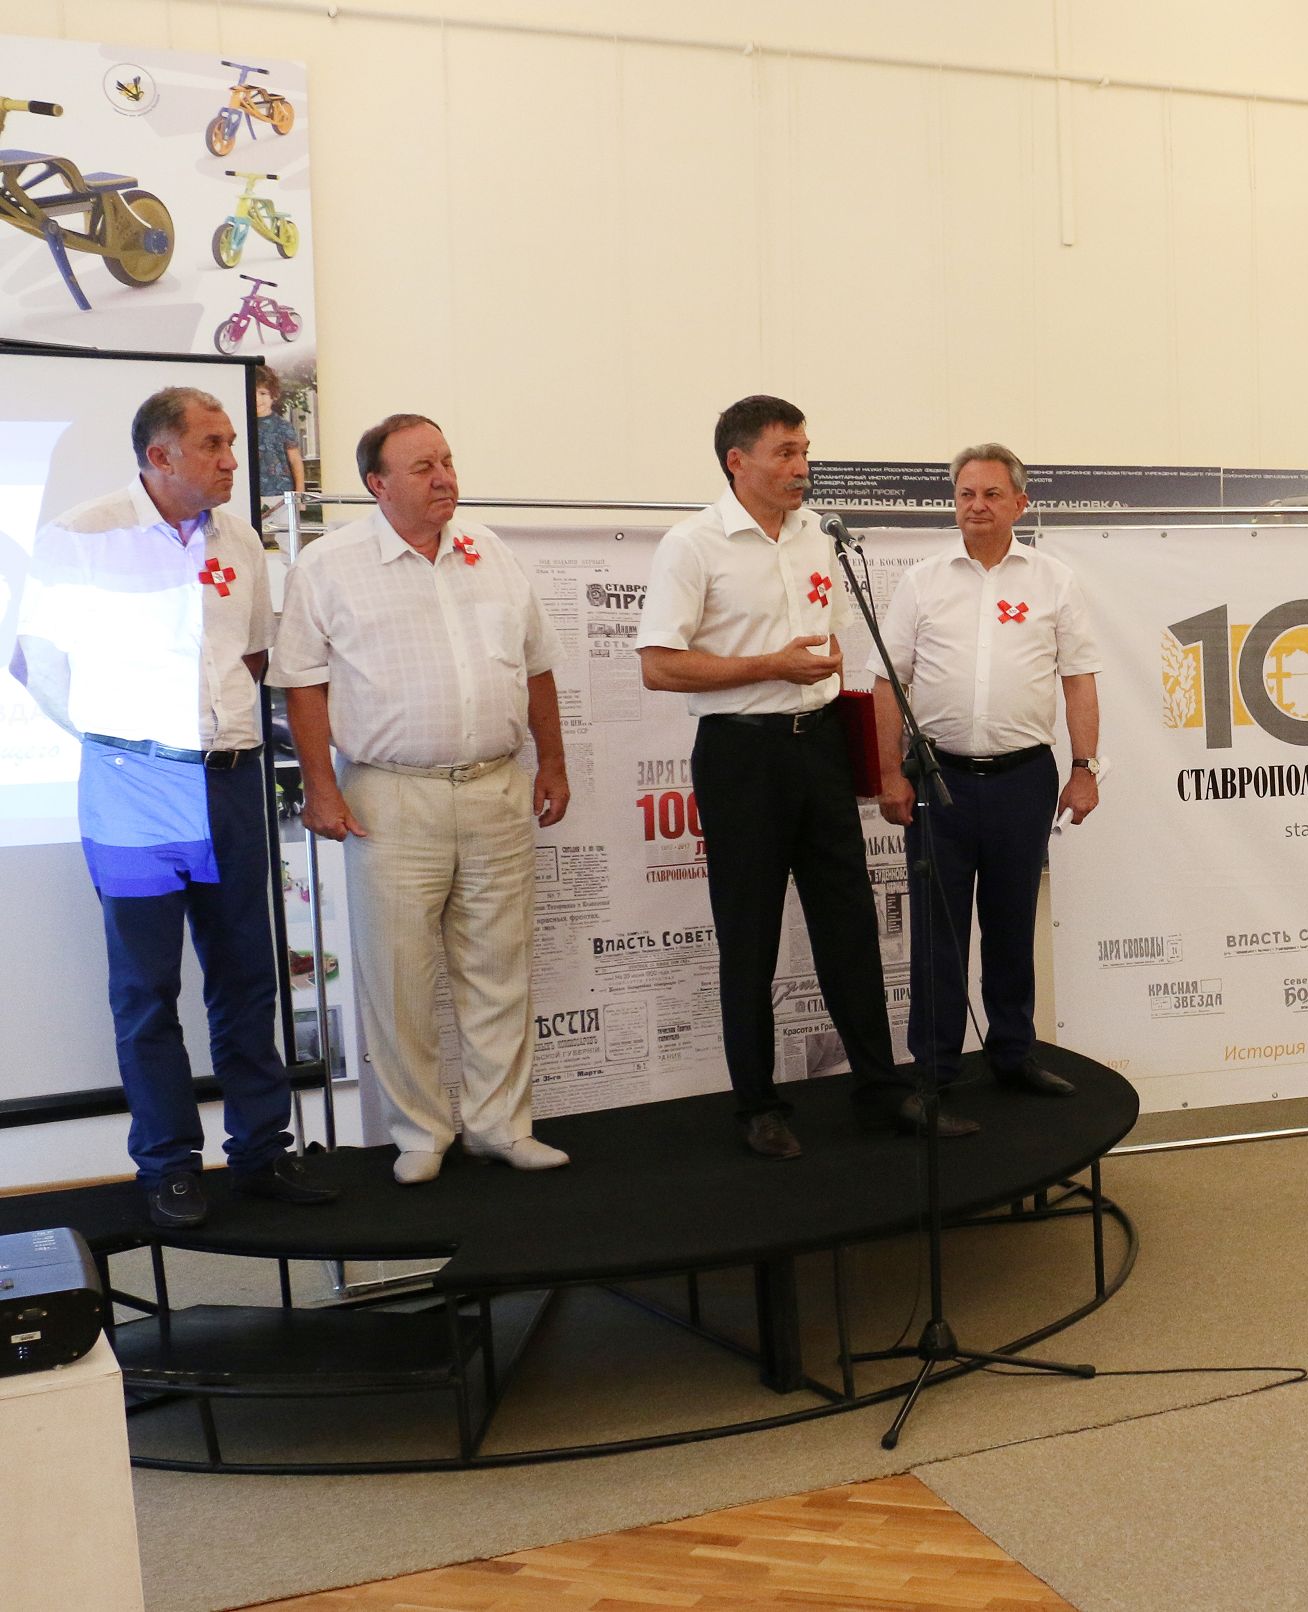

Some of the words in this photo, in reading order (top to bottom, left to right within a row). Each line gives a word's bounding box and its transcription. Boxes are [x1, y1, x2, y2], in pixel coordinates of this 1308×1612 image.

[812, 488, 870, 496] ДИПЛОМНЫЙ
[594, 640, 629, 648] ЕСТЬ
[637, 759, 675, 786] ЗАРЯ
[593, 936, 656, 955] ВЛАСТЬ
[663, 929, 719, 948] СОВЕТ
[1226, 930, 1292, 948] ВЛАСТЬ
[1098, 939, 1121, 962] ЗАРЯ
[1123, 936, 1164, 960] СВОБОДЫ
[1148, 980, 1198, 997] КРАСНАЯ
[1173, 993, 1223, 1010] ЗВЕЗДА
[783, 1025, 813, 1037] Красота
[1224, 1042, 1305, 1062] История
[1106, 1059, 1130, 1071] 1917
